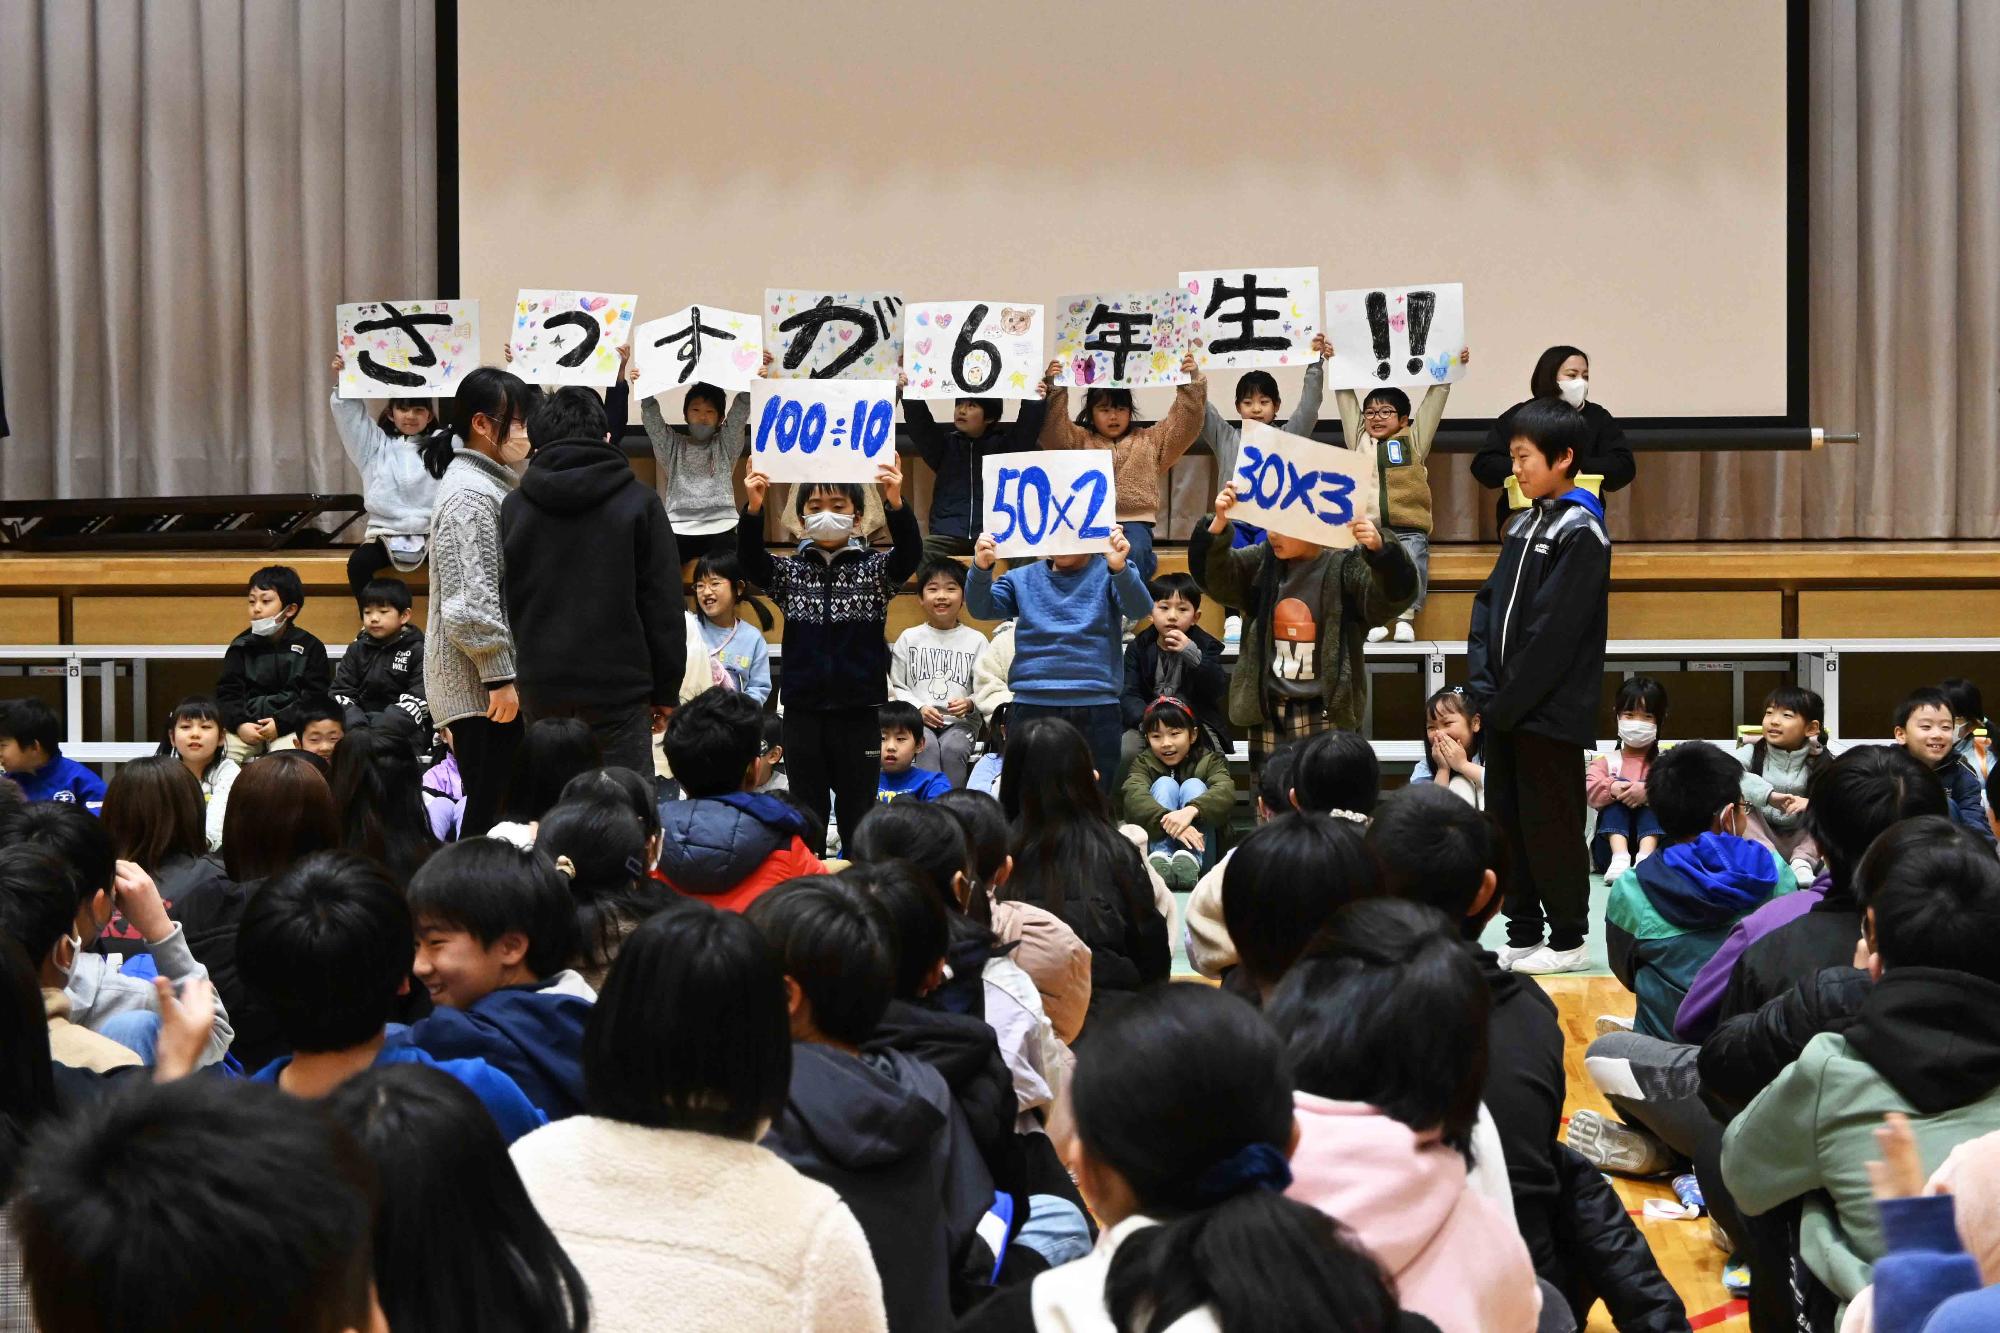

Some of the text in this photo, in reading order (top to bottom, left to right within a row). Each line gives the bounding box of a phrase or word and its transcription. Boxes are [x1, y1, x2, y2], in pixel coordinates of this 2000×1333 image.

[354, 274, 1436, 393] さ つ す が 6 年 生 !!
[755, 394, 893, 458] 100÷10
[392, 663, 408, 672] WILL
[1273, 640, 1316, 680] M
